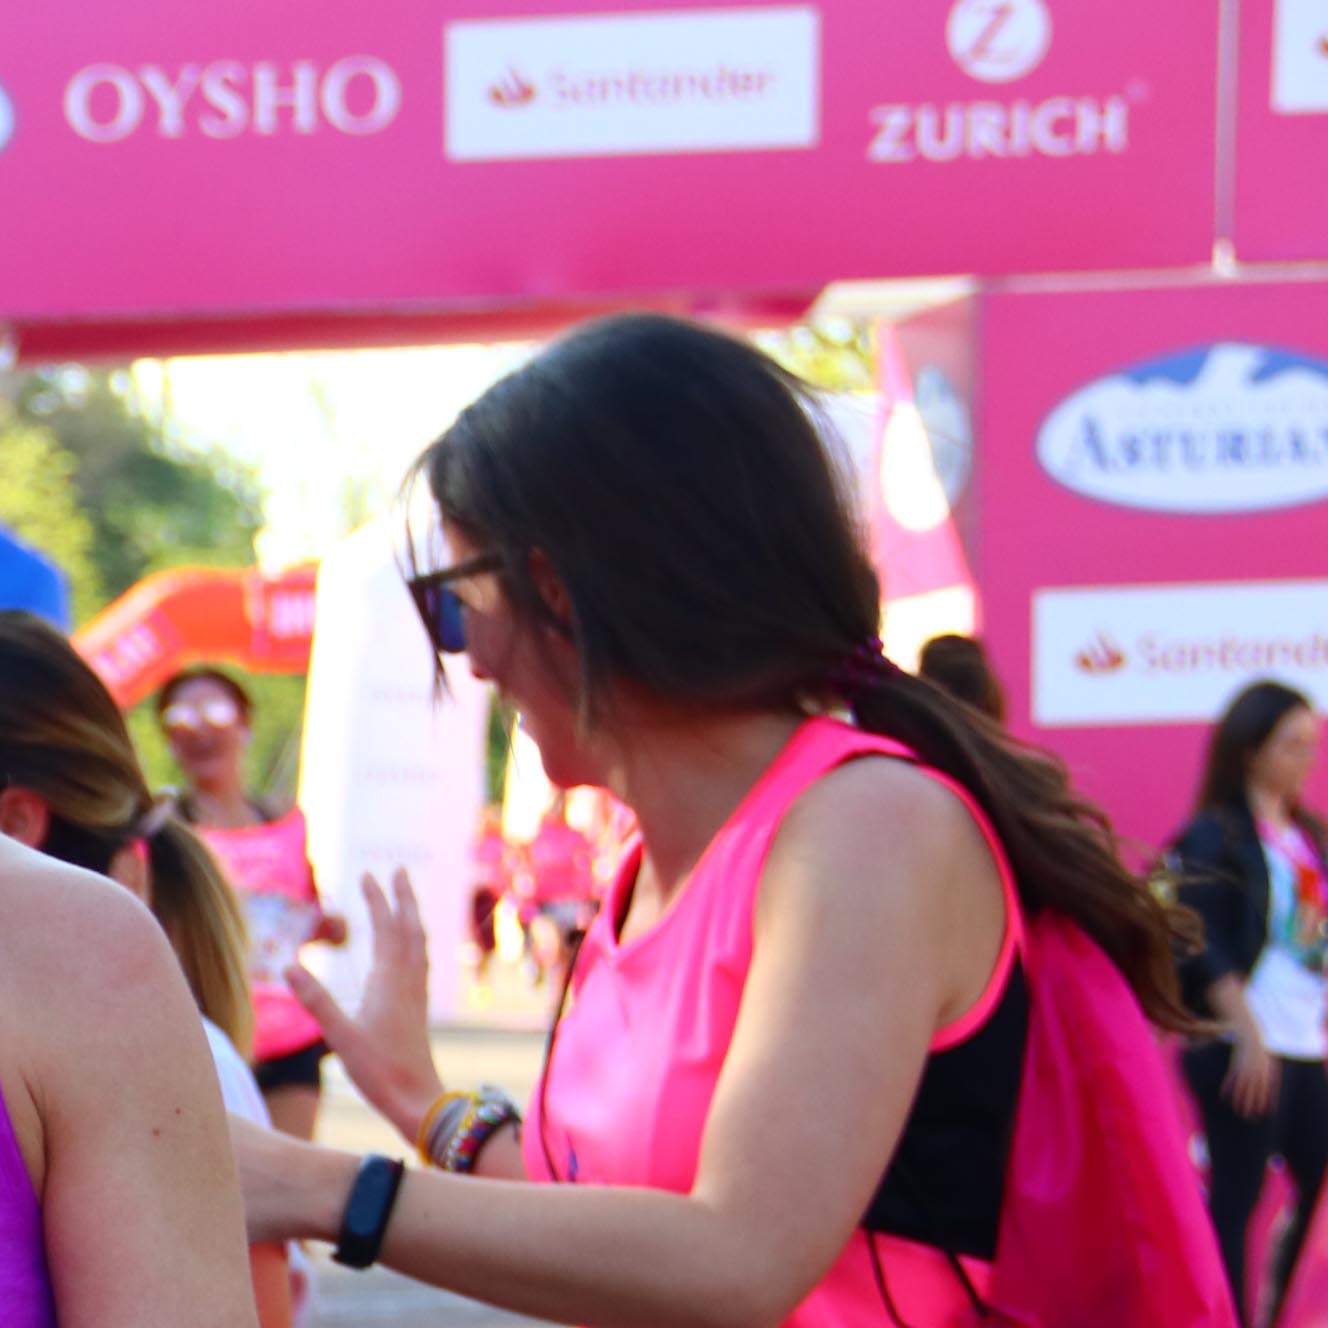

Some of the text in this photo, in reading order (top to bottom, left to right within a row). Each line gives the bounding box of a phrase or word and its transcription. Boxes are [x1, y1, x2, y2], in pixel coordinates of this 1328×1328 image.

[64, 56, 399, 142] OYSHO
[546, 62, 776, 112] Santander
[866, 98, 1128, 162] ZURICH
